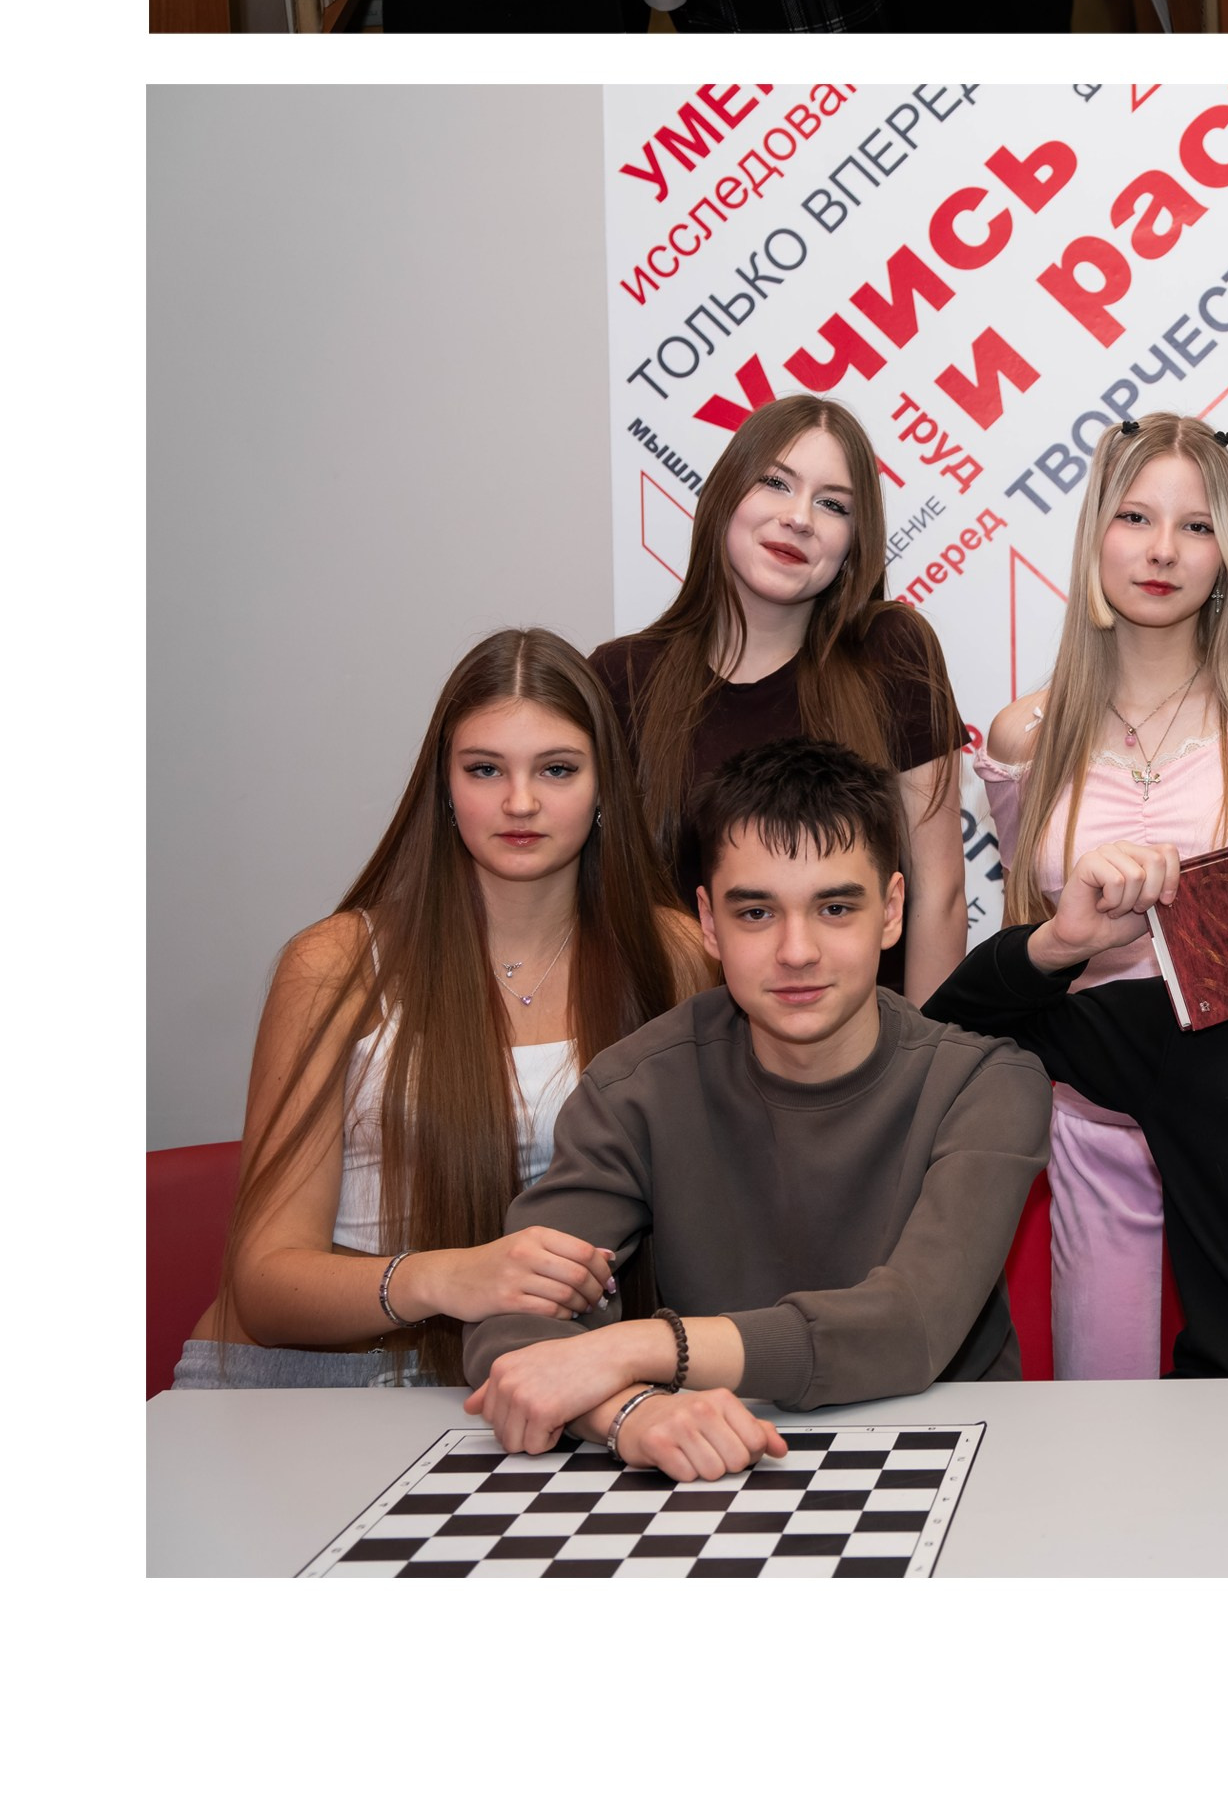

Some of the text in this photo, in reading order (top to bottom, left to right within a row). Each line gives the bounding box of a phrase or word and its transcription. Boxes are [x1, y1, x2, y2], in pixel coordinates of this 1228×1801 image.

[618, 84, 774, 203] УМЕ
[620, 84, 857, 306] исследова
[626, 227, 808, 400] ТОЛЬКО
[933, 325, 1042, 432] и
[627, 417, 703, 498] мышл
[890, 392, 984, 495] труд
